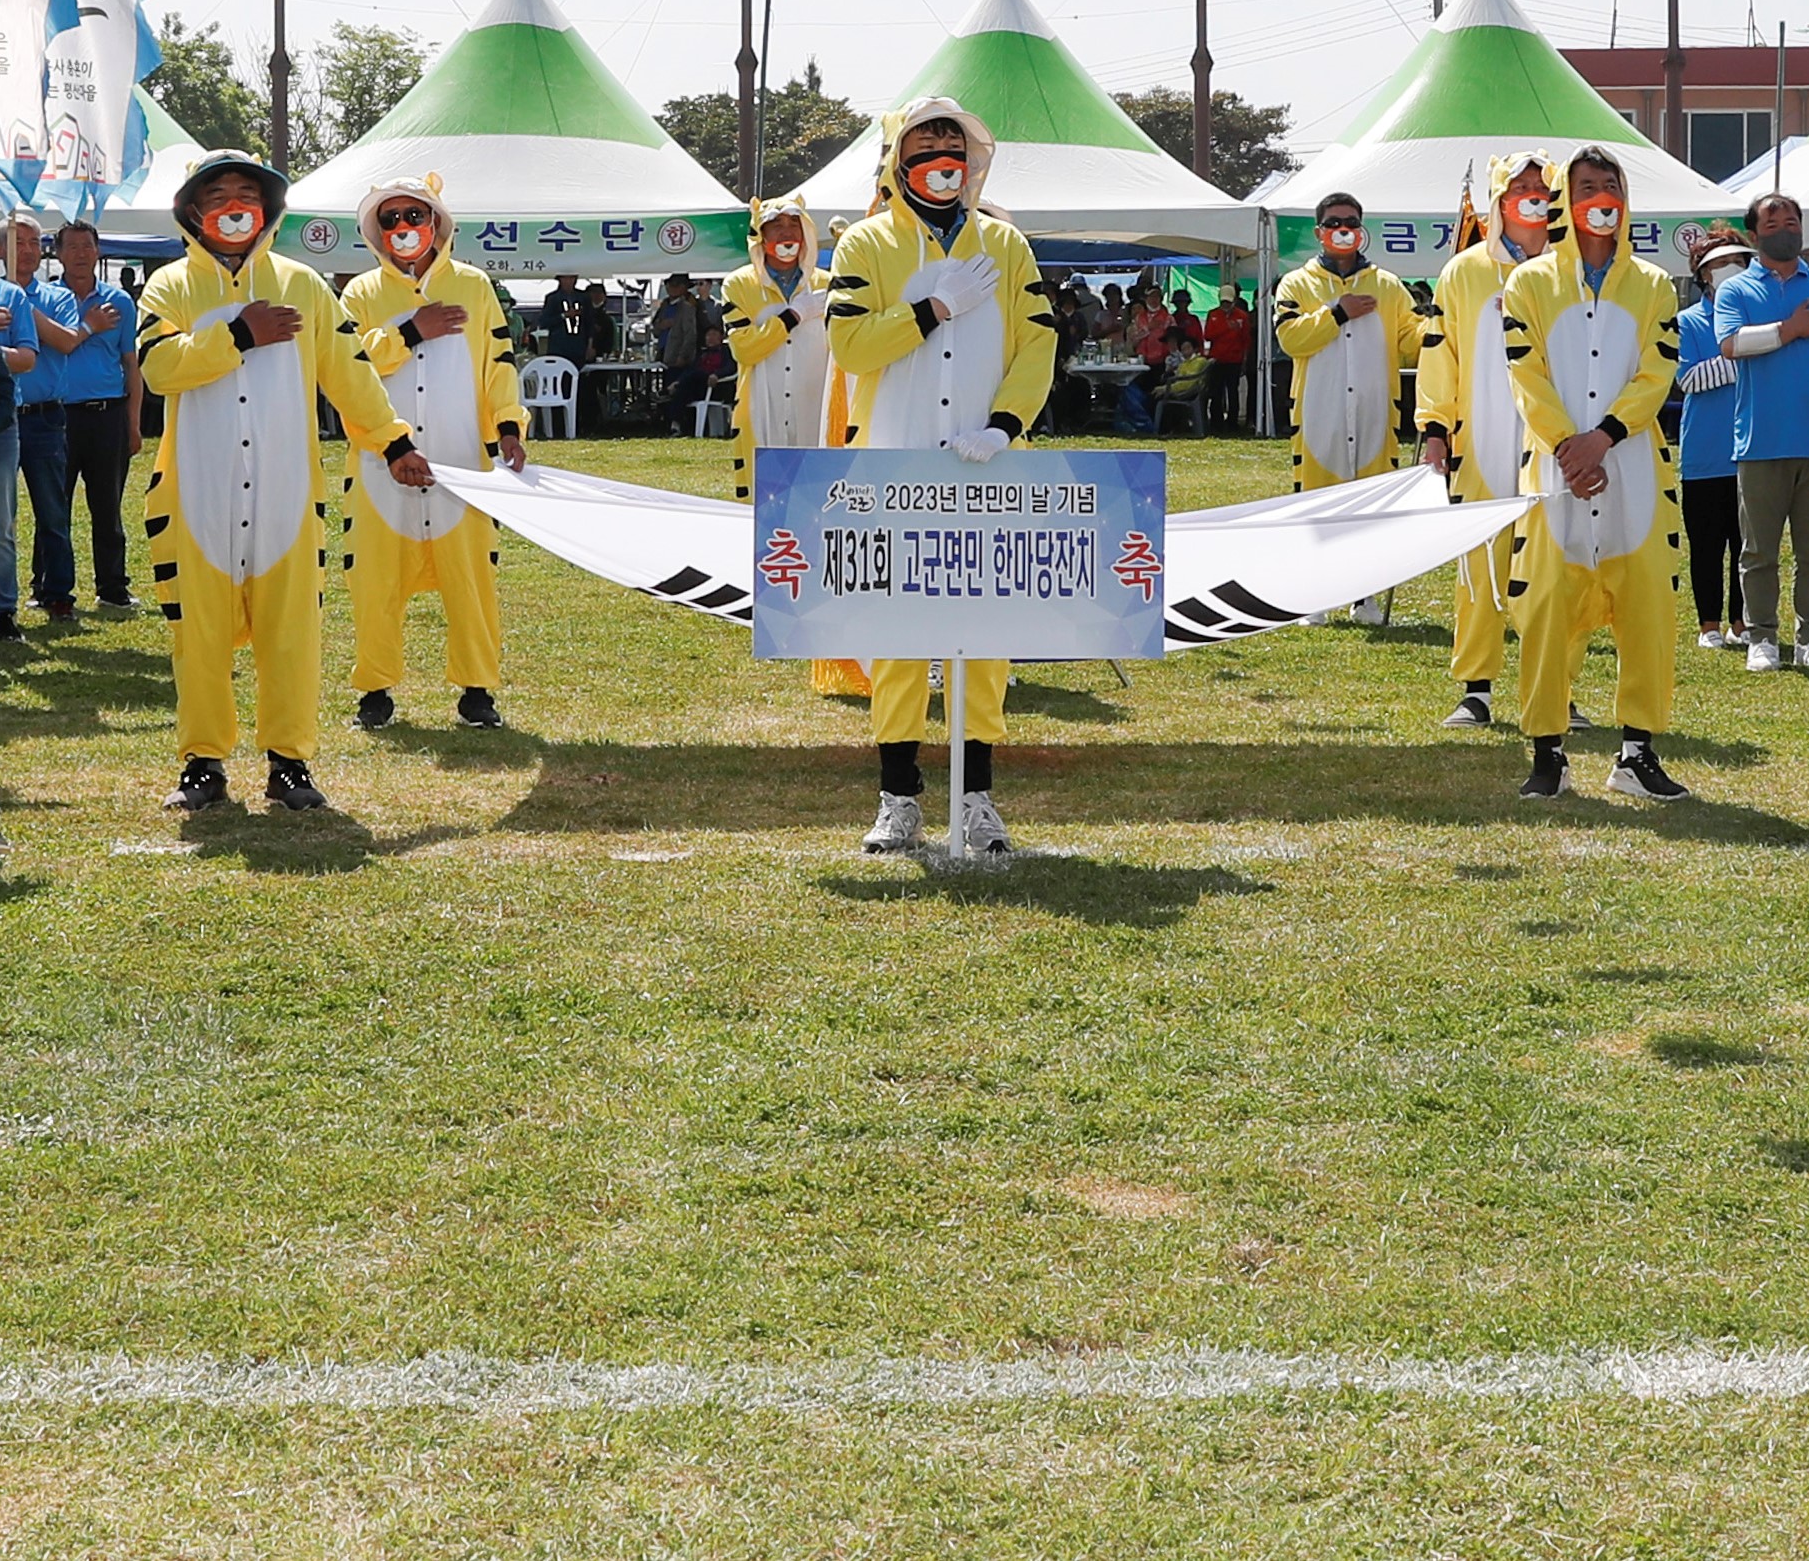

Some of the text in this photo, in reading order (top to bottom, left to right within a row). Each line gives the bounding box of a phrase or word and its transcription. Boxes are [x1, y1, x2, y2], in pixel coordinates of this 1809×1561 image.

[666, 224, 688, 247] 합
[523, 259, 547, 271] 지수
[885, 484, 1095, 514] 2023년 면민의 날 기념
[760, 531, 808, 599] 축
[823, 529, 1095, 598] 제31회 고군면민 한마당잔치
[1114, 533, 1162, 599] 축
